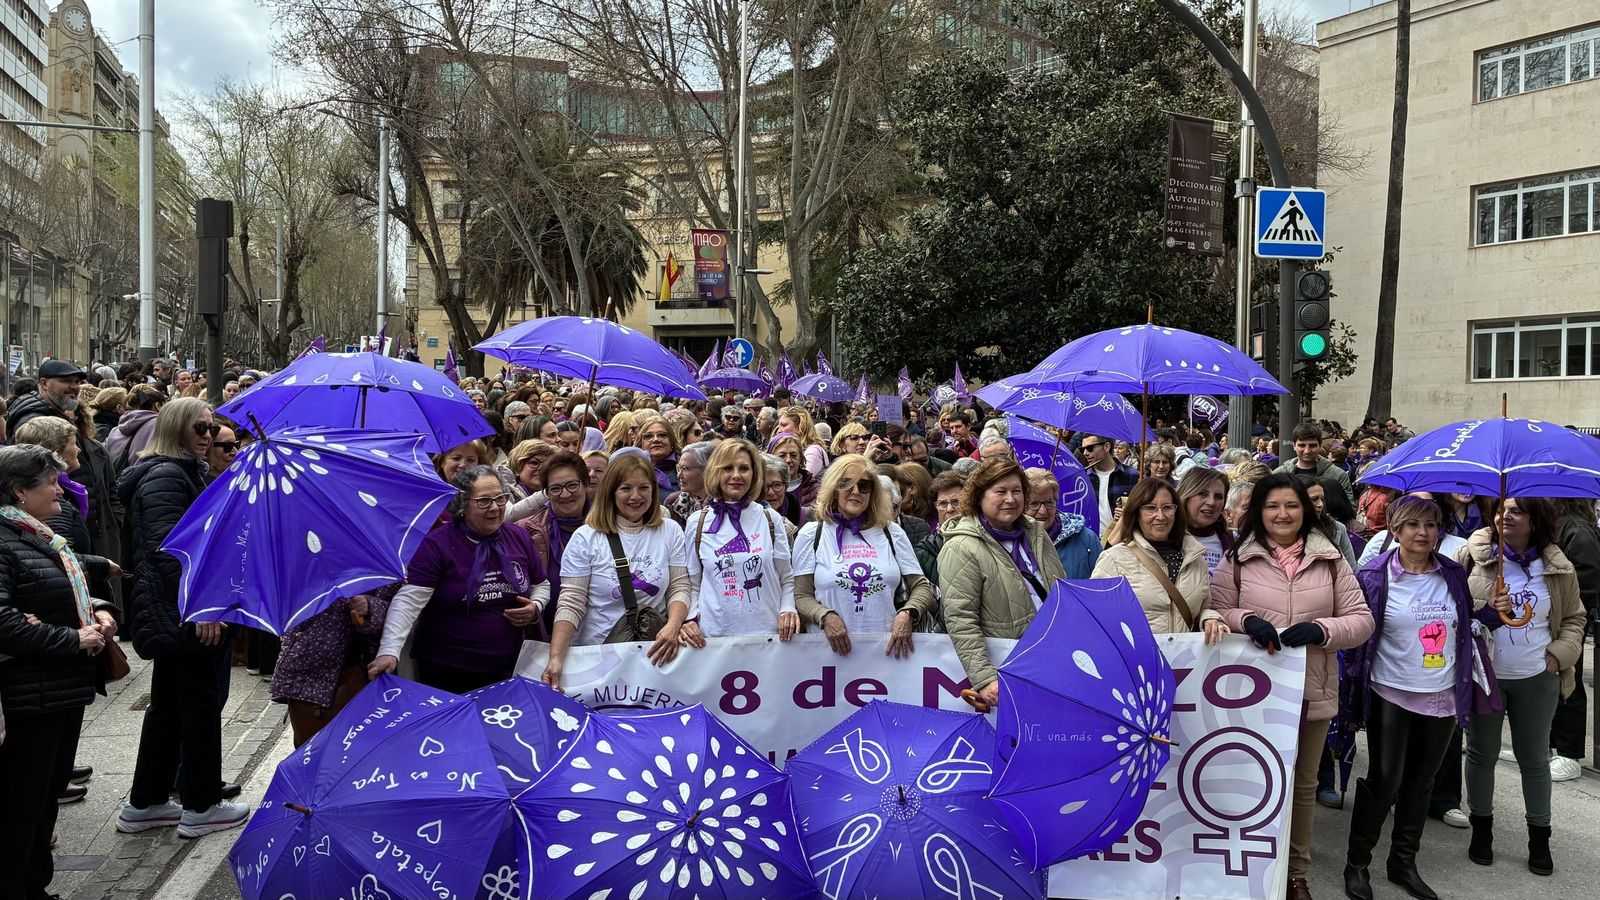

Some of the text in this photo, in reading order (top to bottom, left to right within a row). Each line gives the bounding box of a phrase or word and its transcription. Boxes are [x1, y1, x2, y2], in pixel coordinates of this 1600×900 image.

[1169, 178, 1222, 193] DICCIONARIO
[1168, 193, 1223, 208] AUTORIDADES
[1167, 227, 1212, 237] MAGISTERIO
[694, 233, 722, 247] MAO
[1193, 397, 1216, 417] UGT
[1022, 451, 1045, 466] Soy
[479, 592, 503, 602] ZAIDA
[719, 670, 761, 715] 8
[792, 666, 888, 709] de
[385, 711, 413, 729] una
[1048, 733, 1067, 742] una
[352, 767, 483, 792] No es Tuya
[371, 831, 456, 900] espetala
